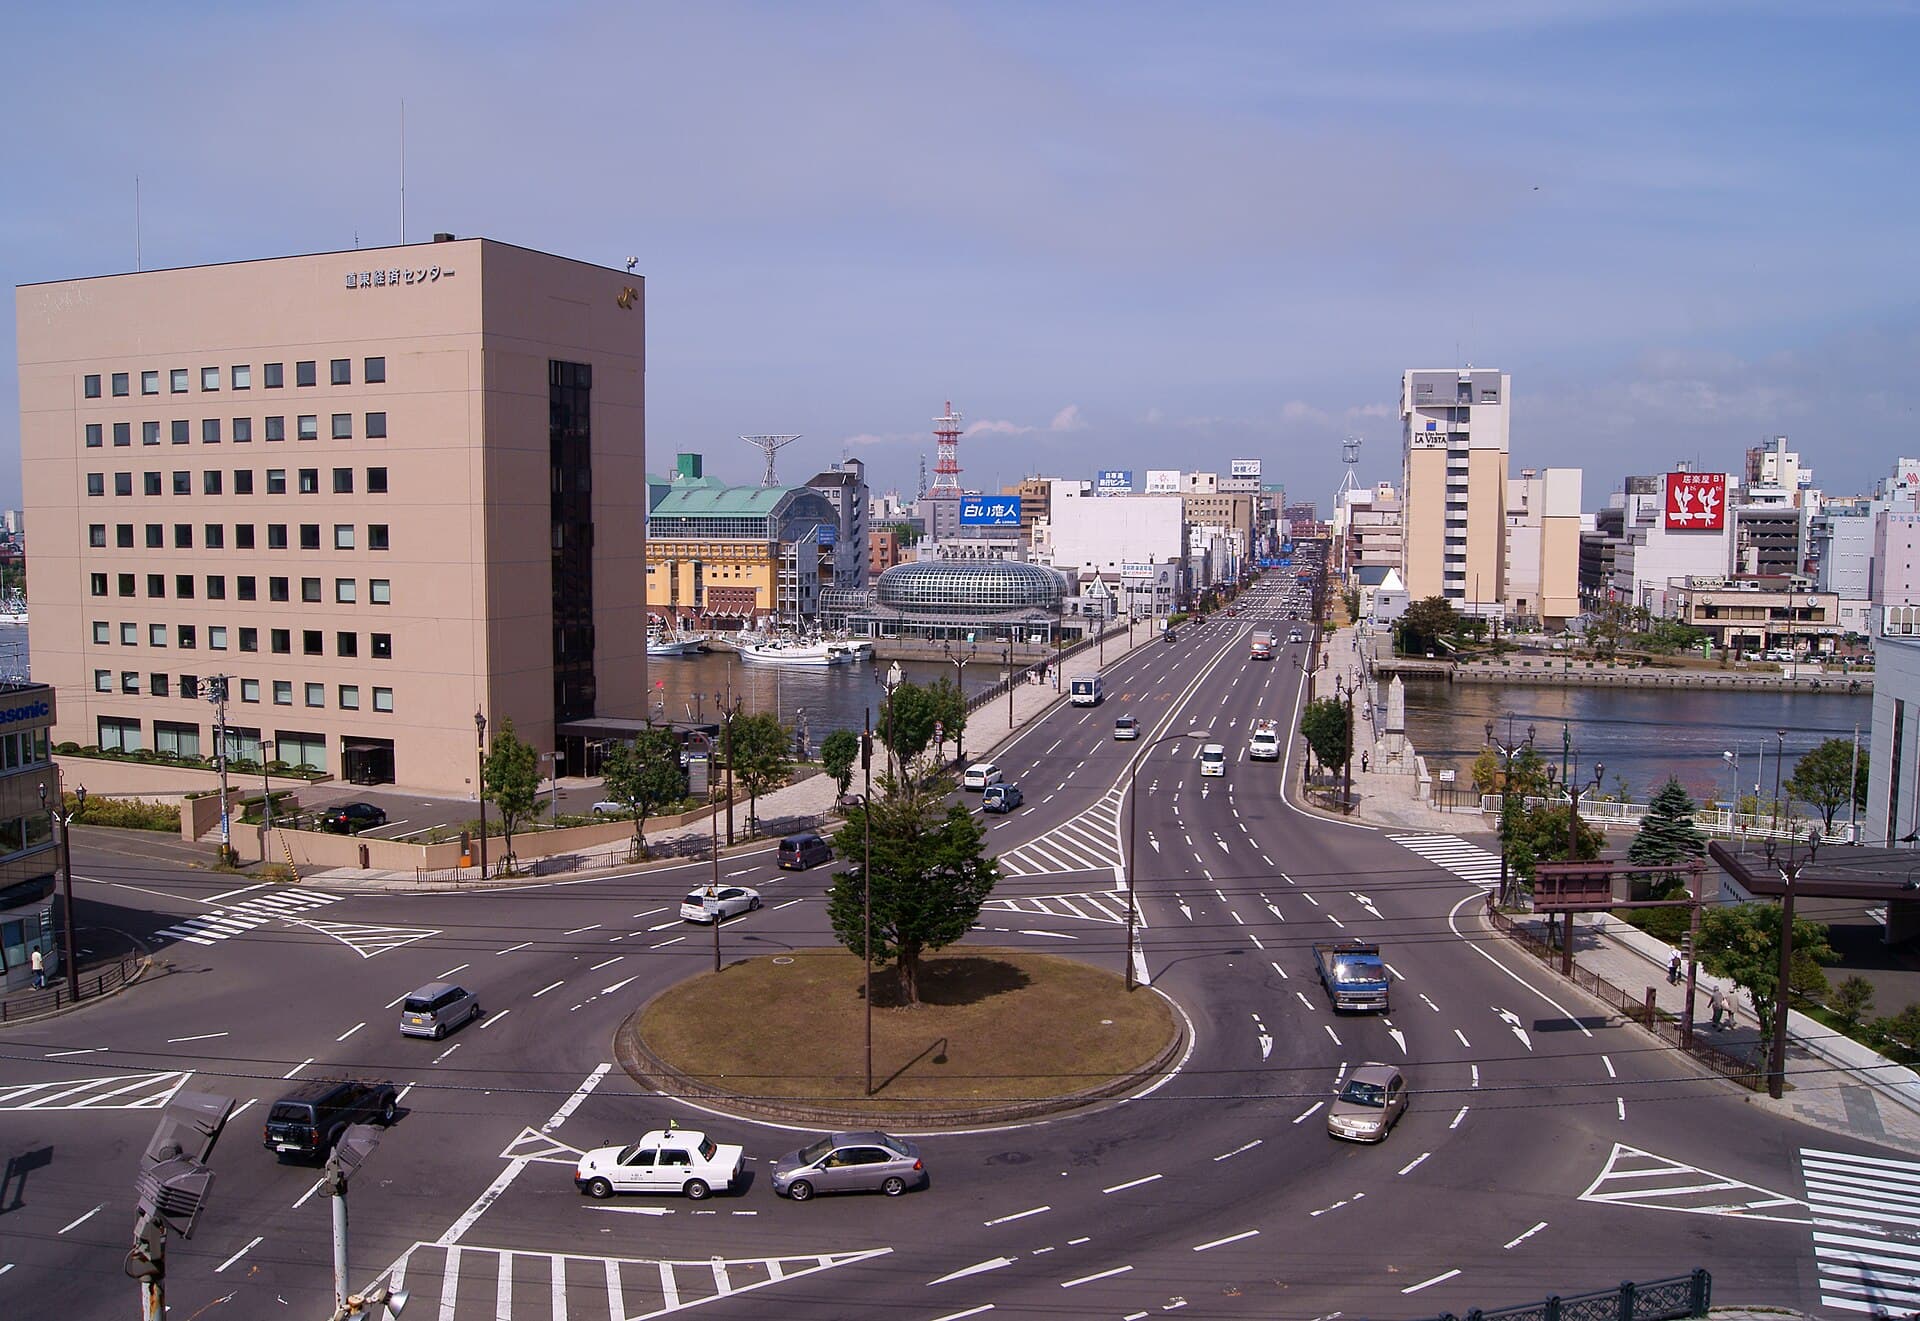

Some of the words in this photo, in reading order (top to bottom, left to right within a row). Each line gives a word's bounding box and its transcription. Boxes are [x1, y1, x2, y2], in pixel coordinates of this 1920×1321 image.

[345, 265, 456, 289] 道東経済センター
[1415, 435, 1424, 443] LA
[1425, 432, 1446, 443] VISTA
[964, 504, 1016, 517] 白い恋人
